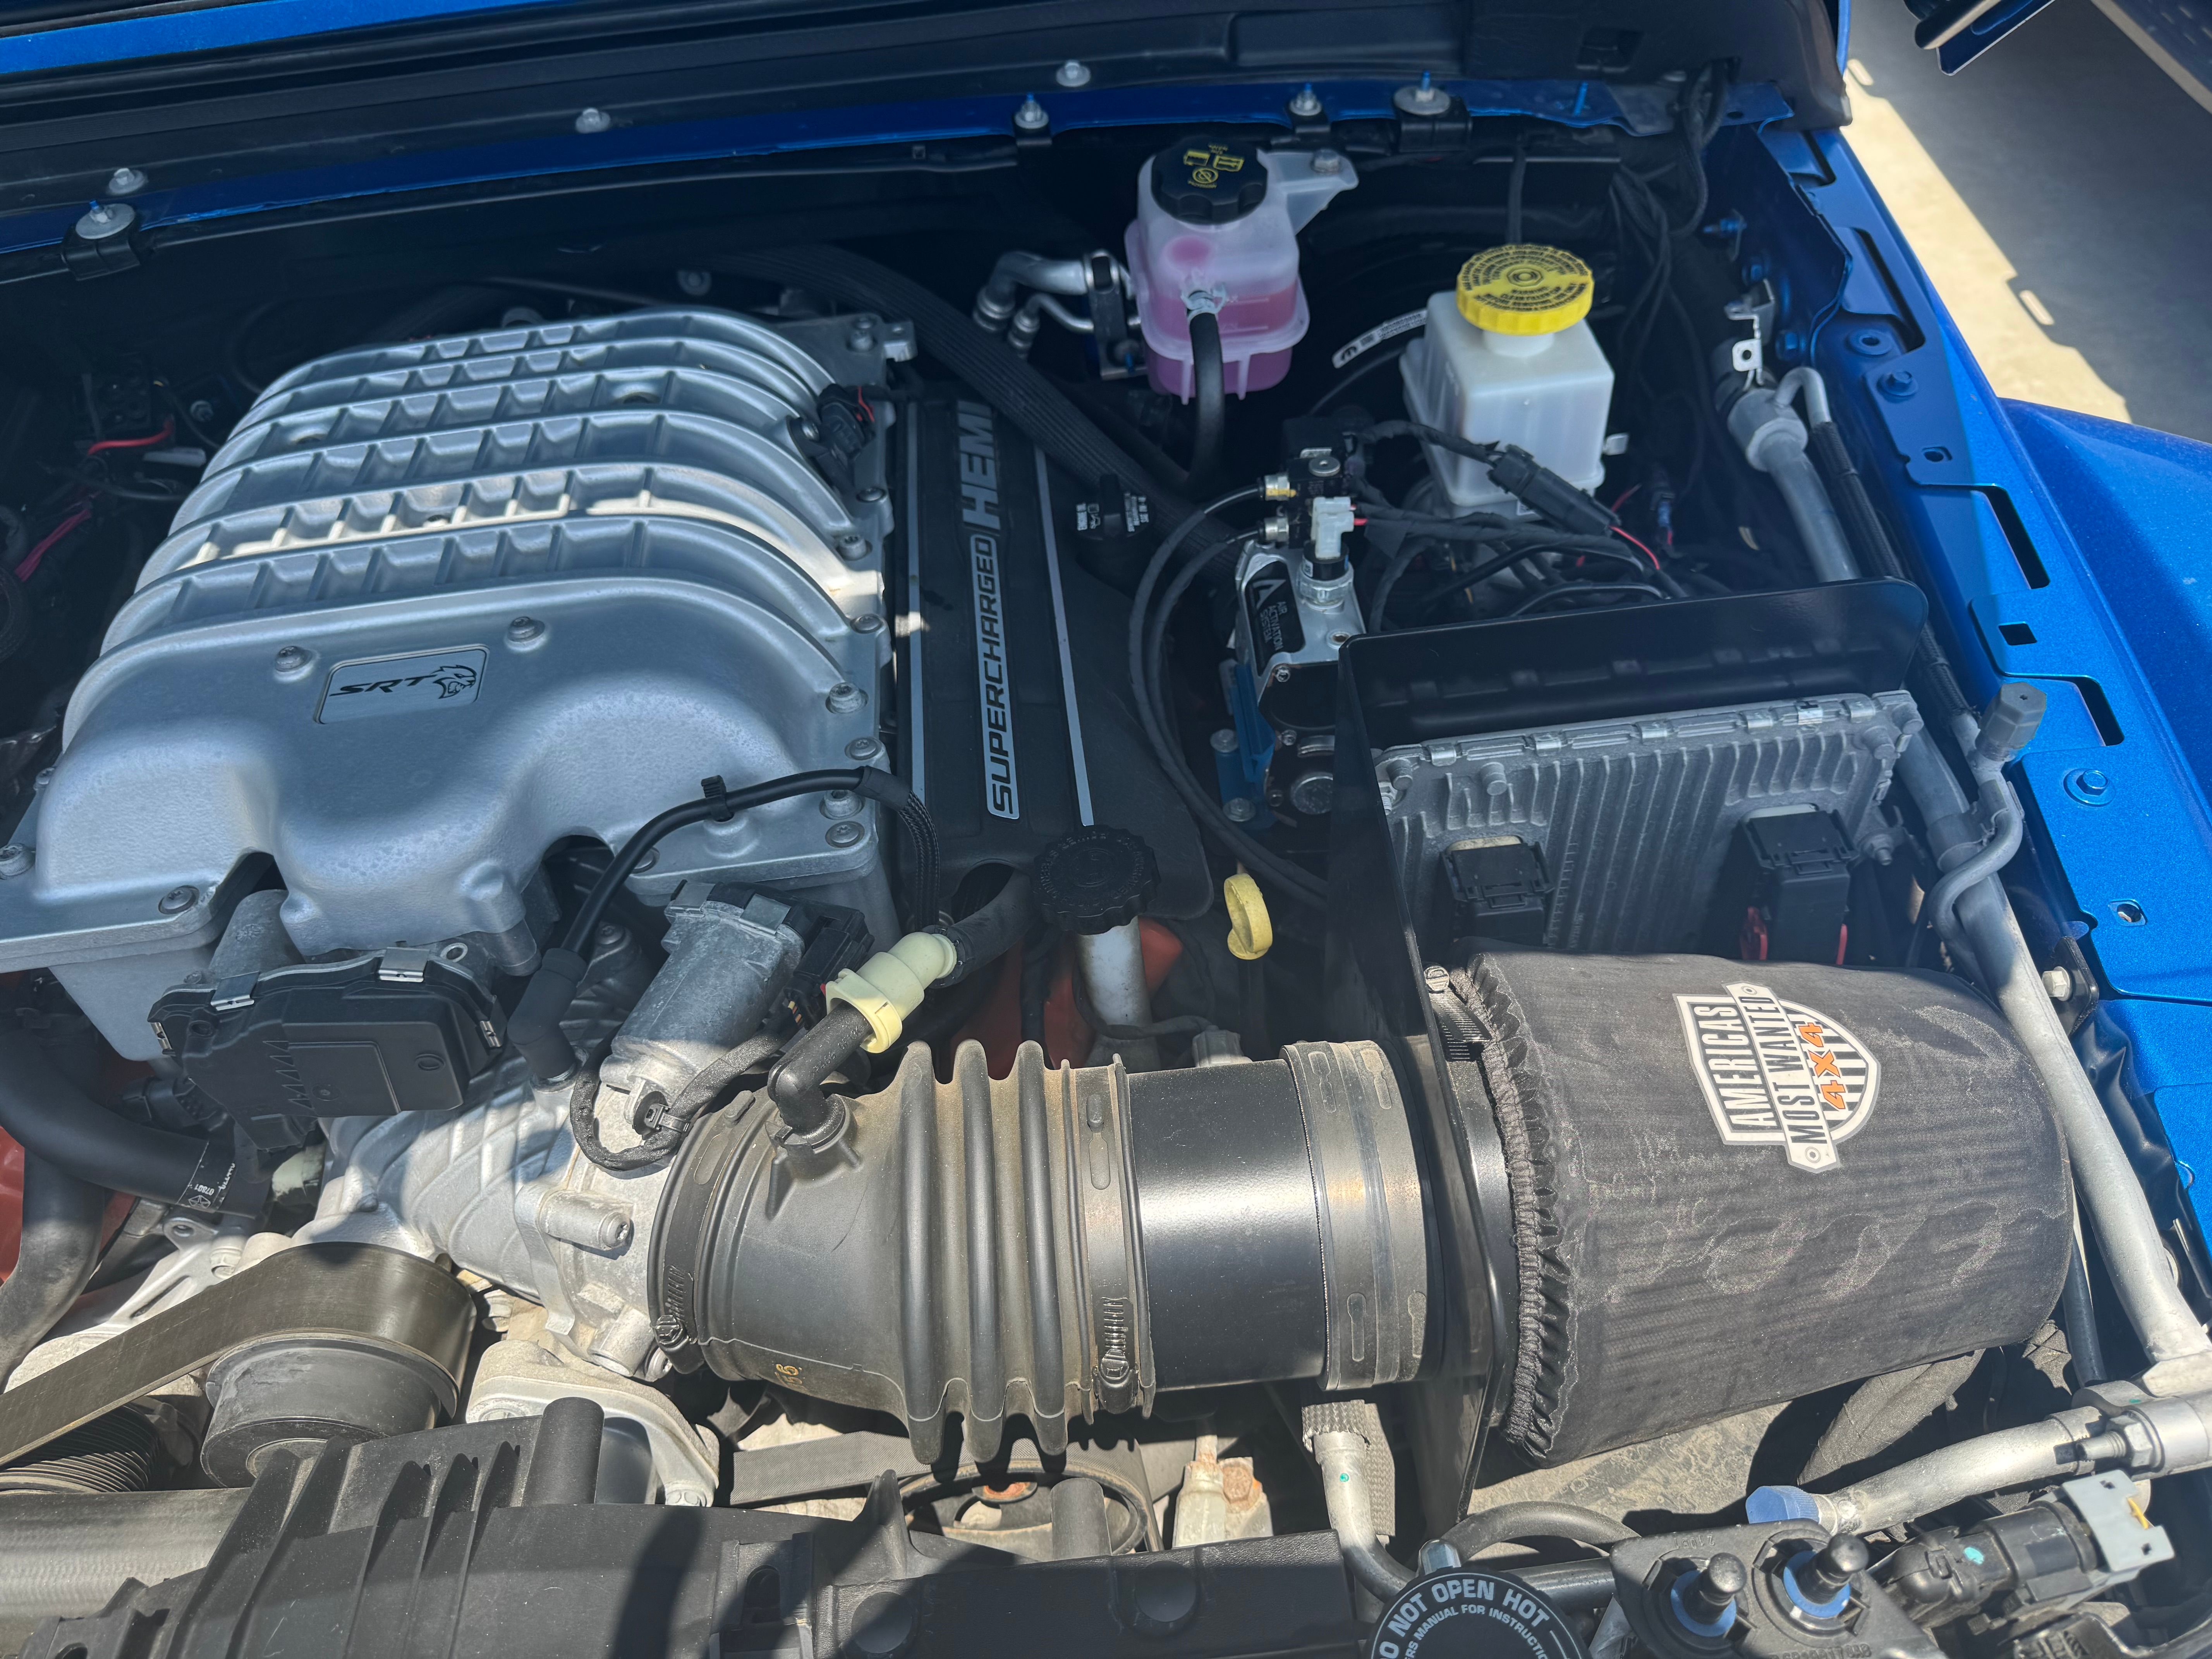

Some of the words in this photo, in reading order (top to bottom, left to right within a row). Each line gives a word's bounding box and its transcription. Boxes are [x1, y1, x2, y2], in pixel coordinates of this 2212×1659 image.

[957, 400, 1001, 531] HEMI
[1277, 601, 1288, 615] AIR
[329, 674, 438, 697] SRT
[974, 537, 1013, 814] SUPERCHARGED
[1737, 996, 1805, 1073] WANTED
[1693, 1006, 1778, 1127] AMERICAS
[1772, 1081, 1828, 1144] MOST
[1387, 1592, 1428, 1637] NOT
[1431, 1579, 1495, 1603] OPEN
[1503, 1588, 1550, 1627] HOT
[1413, 1606, 1459, 1640] MANUAL
[1461, 1604, 1485, 1614] FOR
